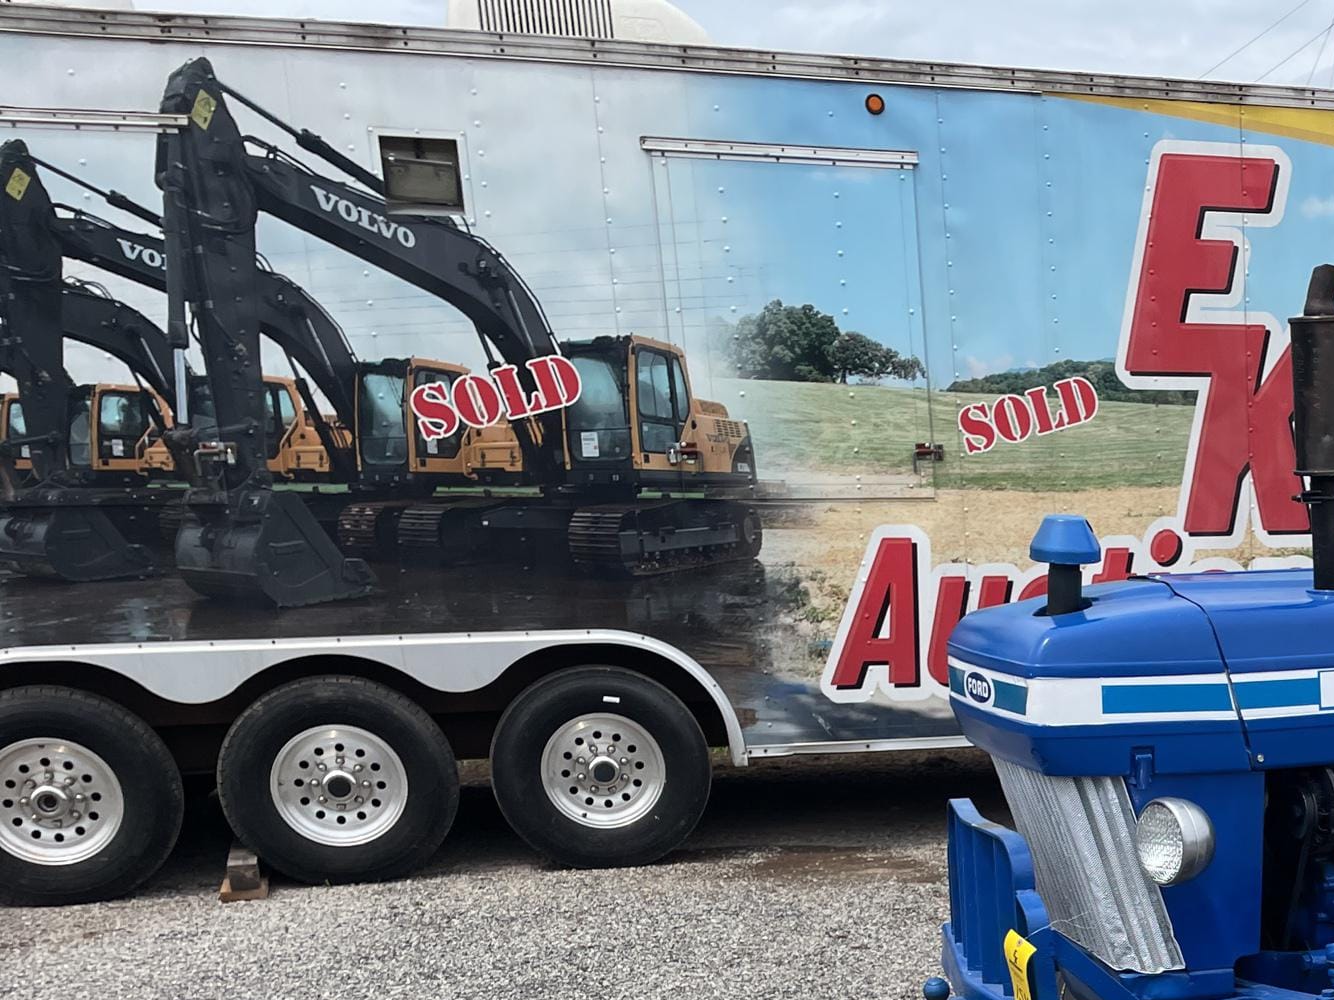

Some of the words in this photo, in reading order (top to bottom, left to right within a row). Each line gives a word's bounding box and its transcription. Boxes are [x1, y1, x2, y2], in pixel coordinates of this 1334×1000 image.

[309, 185, 416, 248] VOLVO
[410, 356, 582, 440] SOLD
[959, 377, 1099, 455] SOLD
[967, 677, 989, 698] FORD
